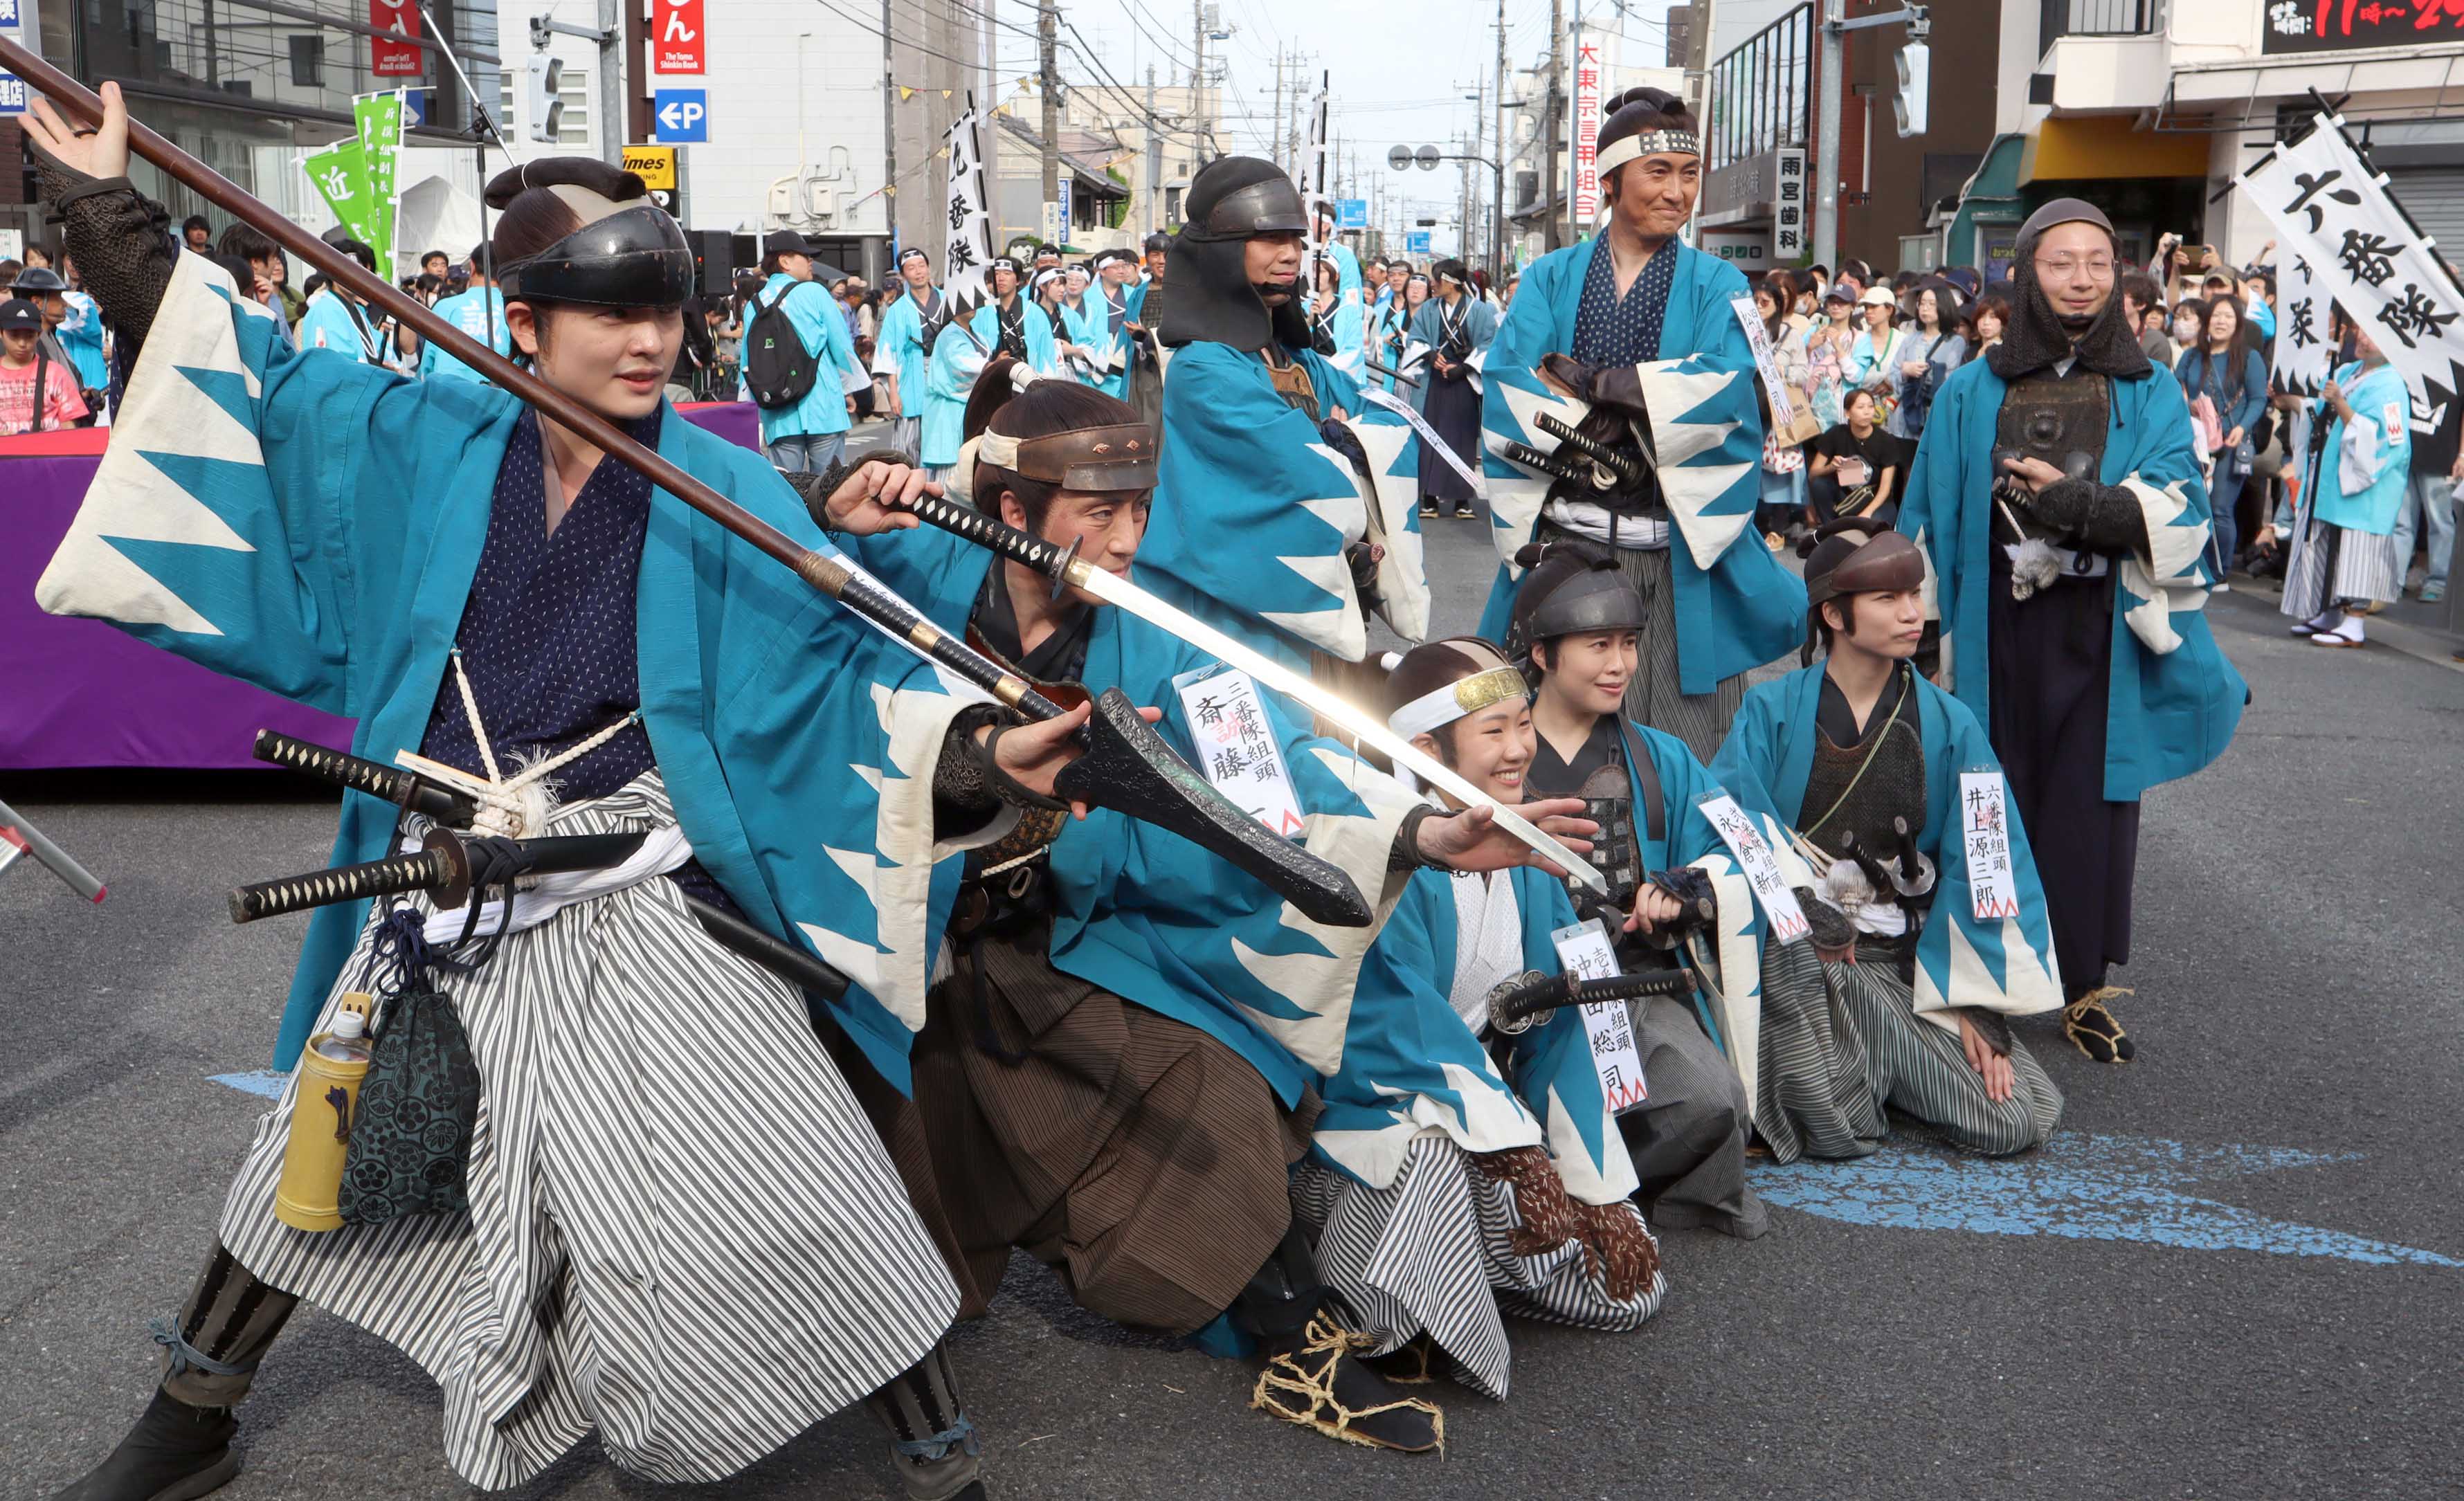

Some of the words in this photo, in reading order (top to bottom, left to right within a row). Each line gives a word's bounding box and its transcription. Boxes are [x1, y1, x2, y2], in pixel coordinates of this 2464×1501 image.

[664, 0, 696, 42] ん
[622, 155, 666, 170] imes
[683, 102, 703, 129] P
[1576, 42, 1598, 215] 大東京信用組合
[948, 140, 979, 278] 九番隊
[1779, 156, 1801, 250] 雨宮歯科
[2283, 169, 2461, 349] 六番隊
[1227, 681, 1280, 783] 三番隊組頭
[1716, 813, 1791, 926] 永倉新八
[1966, 786, 1996, 907] 井上源三郎
[1986, 784, 2008, 872] 六番隊組頭
